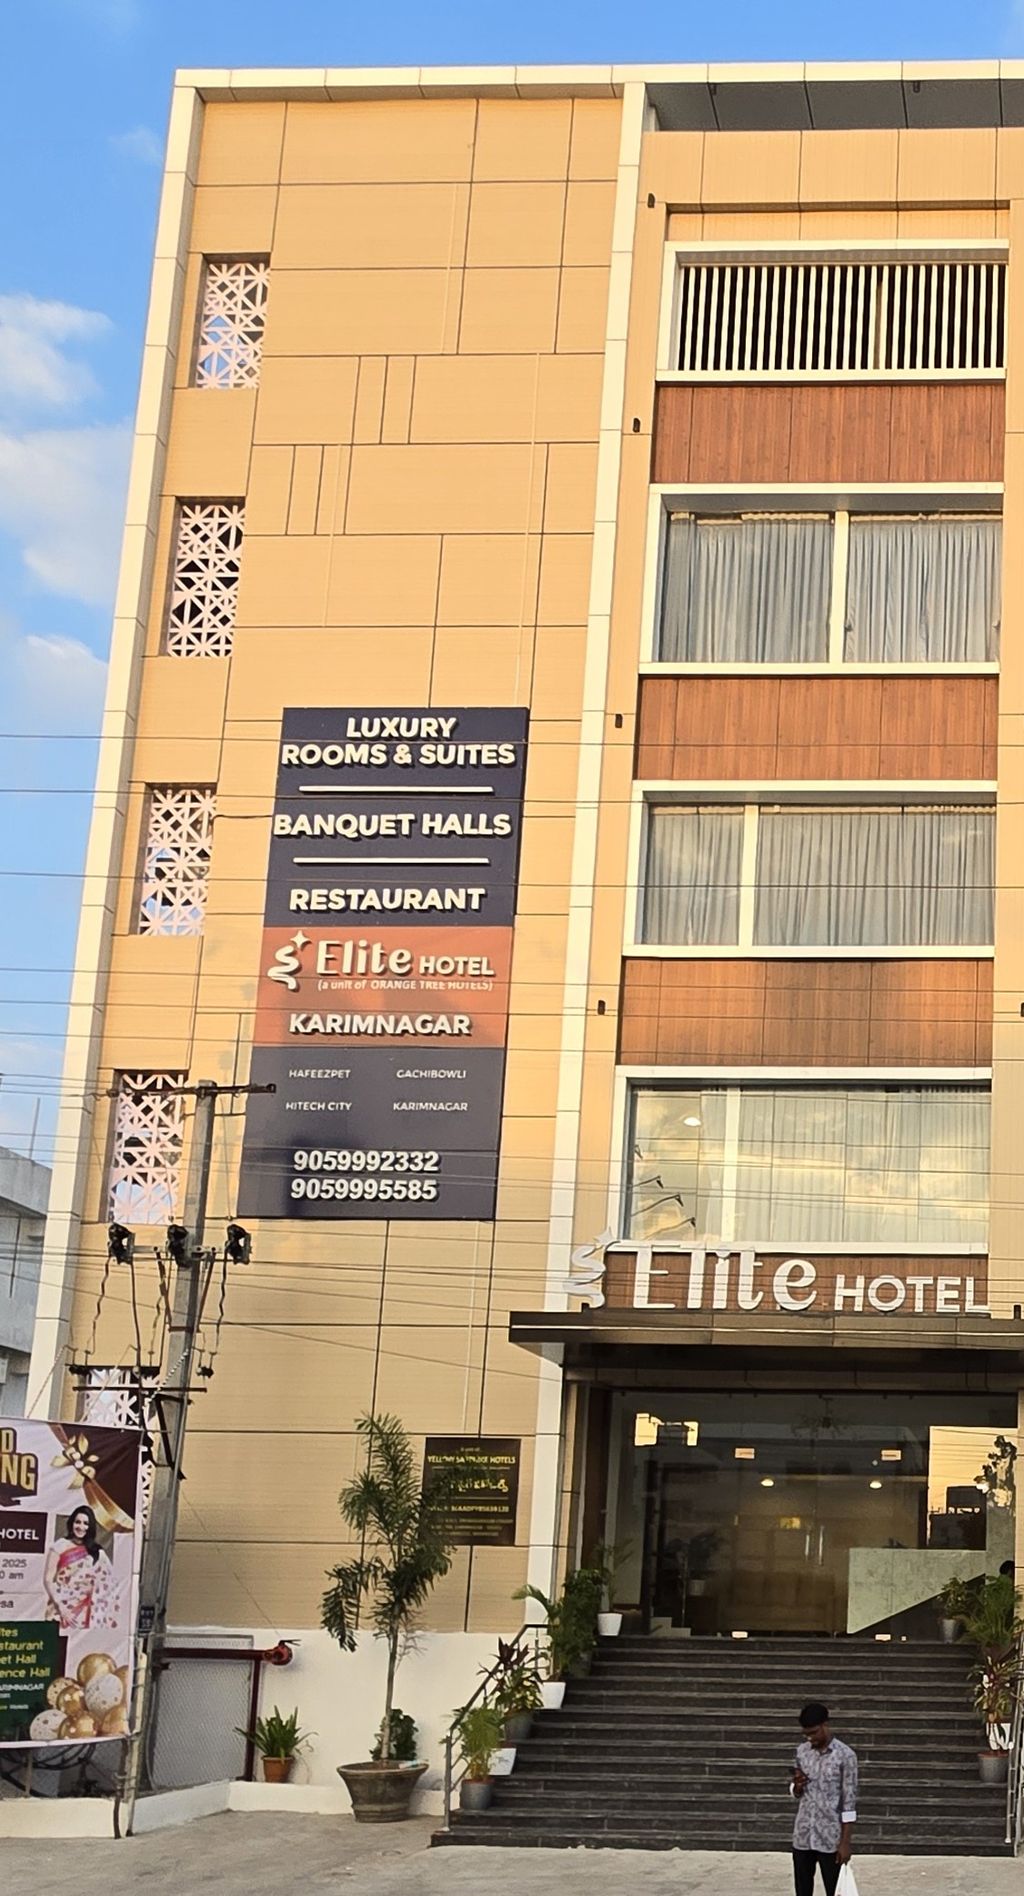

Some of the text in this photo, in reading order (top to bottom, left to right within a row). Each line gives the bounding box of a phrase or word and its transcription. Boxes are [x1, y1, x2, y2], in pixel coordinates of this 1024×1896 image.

[346, 717, 457, 738] LUXURY
[281, 744, 515, 766] ROOMS & SUITES
[273, 813, 512, 838] BANQUET HALLS
[289, 888, 485, 911] RESTAURANT
[316, 939, 495, 976] Elite HOTEL
[354, 979, 367, 989] of
[371, 980, 416, 990] ORANGE
[420, 980, 445, 990] TREE
[289, 1013, 471, 1035] KARIMNAGAR
[289, 1069, 351, 1079] HAFEEZPET
[396, 1069, 466, 1079] GACHIBOWLI
[286, 1101, 352, 1111] HITECH CITY
[393, 1102, 468, 1111] KARIMNAGAR
[293, 1150, 440, 1172] 9059992332
[291, 1179, 437, 1201] 9059995585
[632, 1243, 991, 1313] Elite HOTEL
[2, 1559, 27, 1568] 2025
[16, 1655, 36, 1664] Hall
[30, 1667, 50, 1677] Hall
